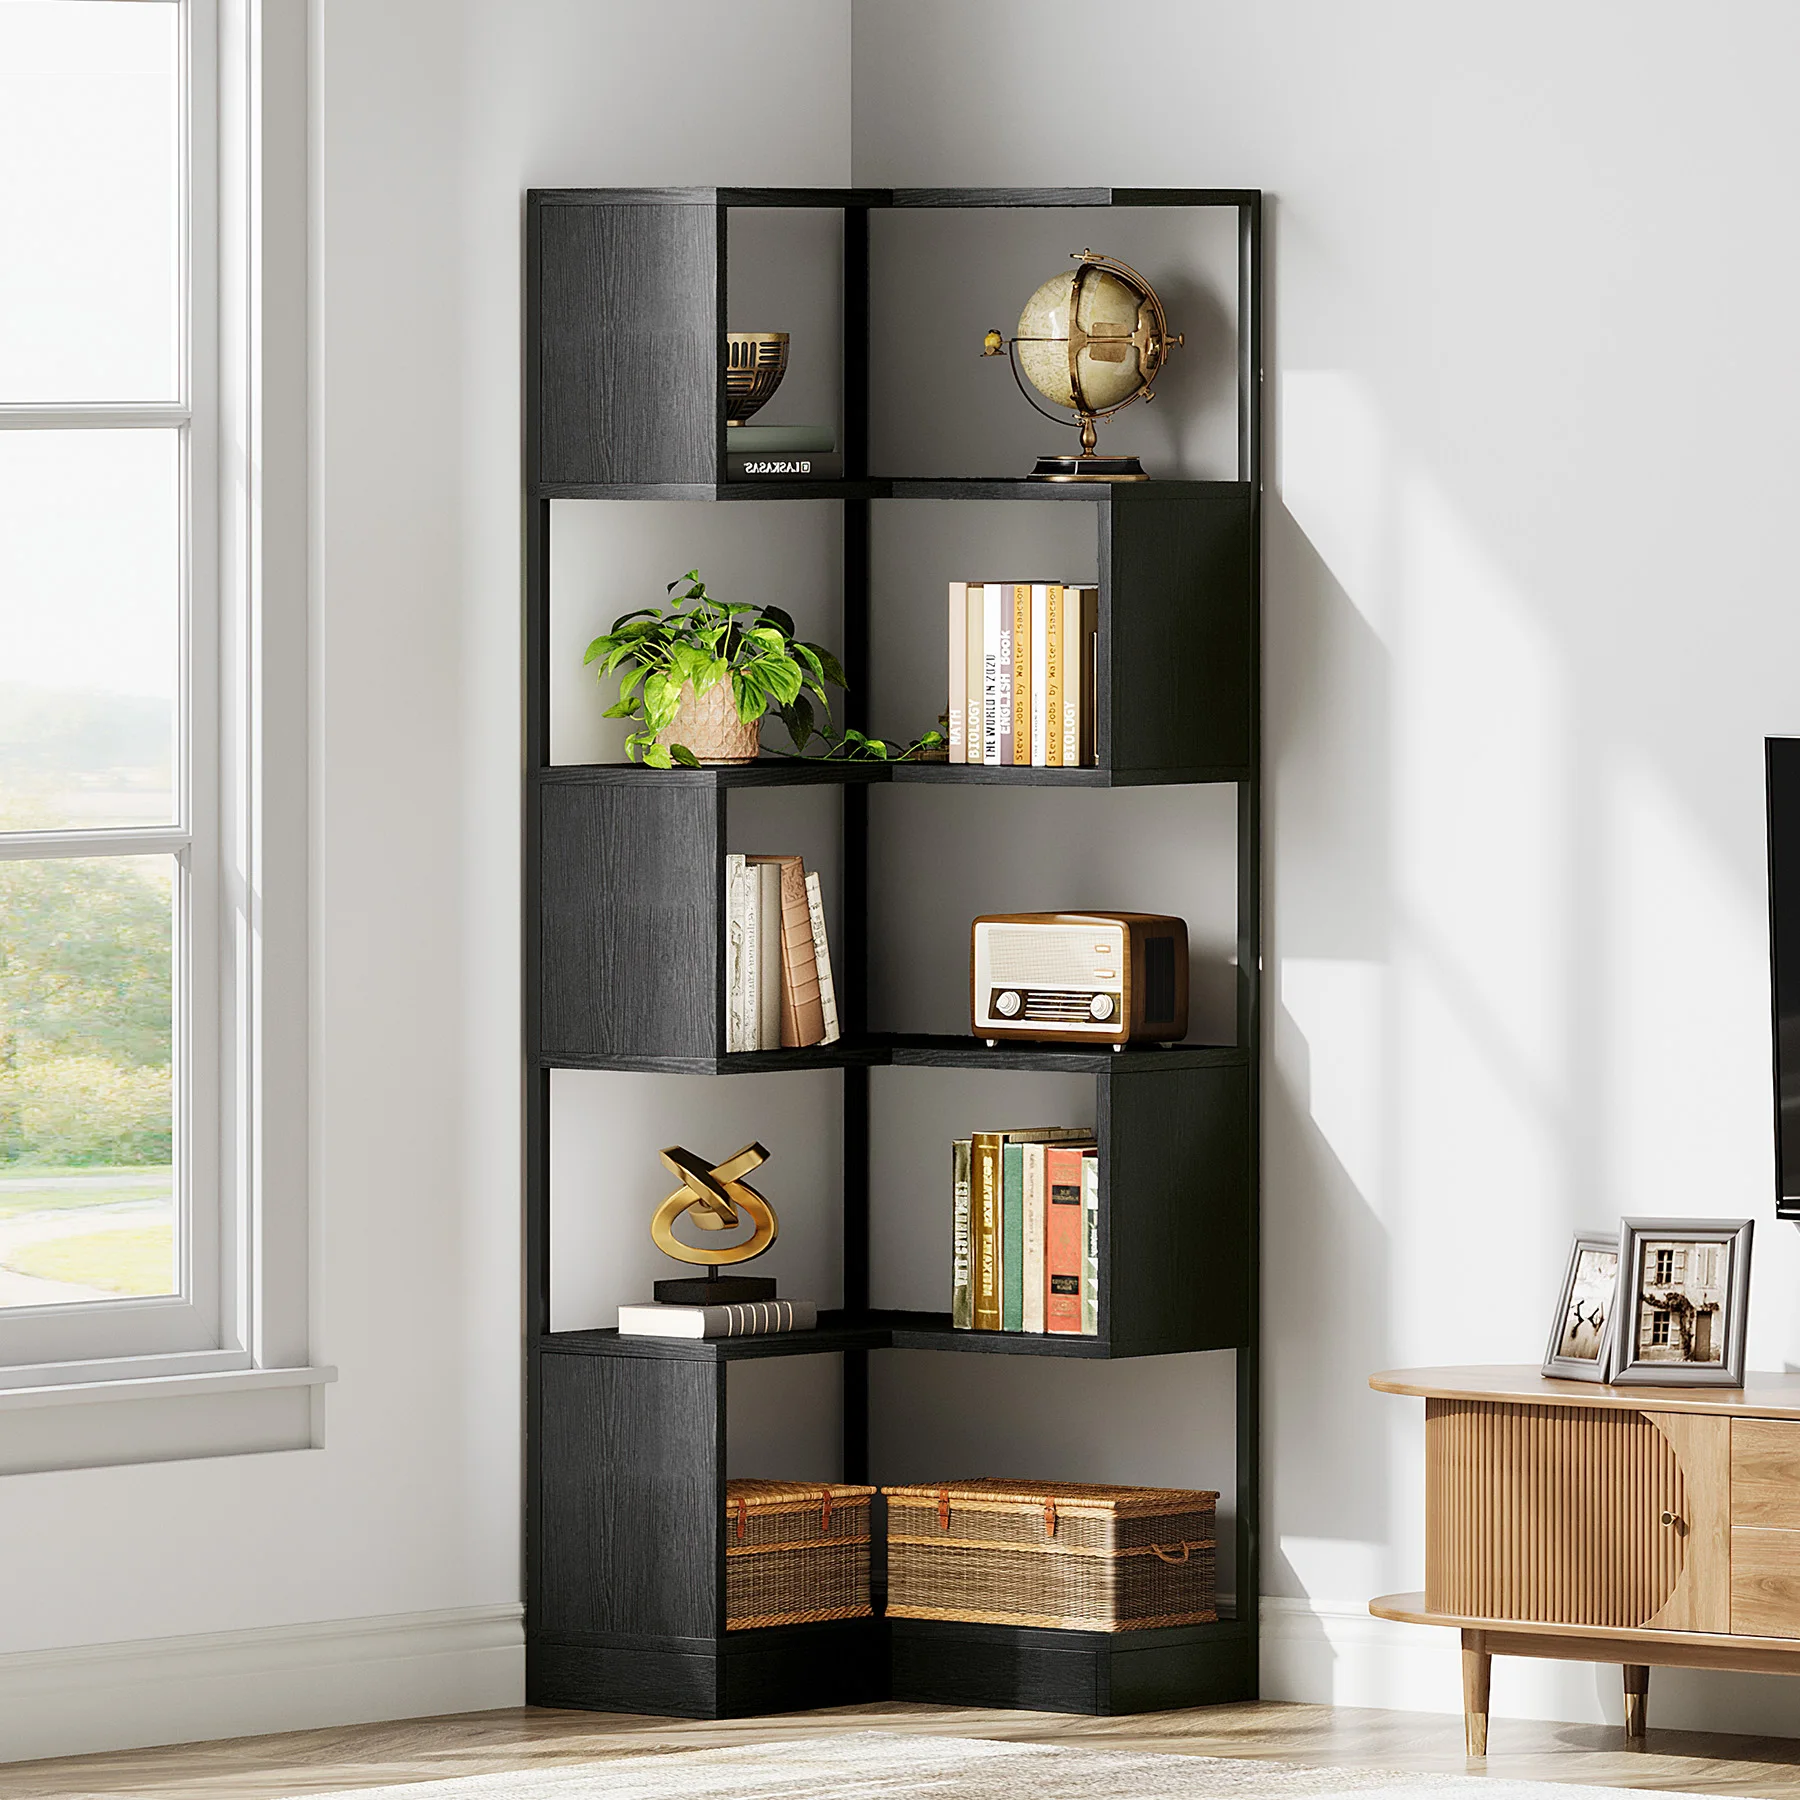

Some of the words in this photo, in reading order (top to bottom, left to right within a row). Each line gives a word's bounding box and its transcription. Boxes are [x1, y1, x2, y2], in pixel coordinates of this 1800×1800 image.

[1015, 587, 1024, 635] Isaacson
[1048, 587, 1056, 636] Isaacson
[985, 654, 996, 682] 2020
[1015, 641, 1024, 678] Walter
[1048, 642, 1056, 679] Walter
[985, 684, 996, 696] IN
[1000, 673, 1011, 735] ENGLISH
[1015, 683, 1027, 695] by
[1048, 683, 1059, 696] by
[949, 708, 962, 746] MATH
[967, 698, 981, 759] BIOLOGY
[985, 698, 996, 737] WORLD
[1015, 700, 1024, 725] Jobs
[1048, 701, 1056, 726] Jobs
[1015, 730, 1024, 761] Steve
[1048, 731, 1056, 762] Steve
[1063, 700, 1076, 761] BIOLOGY
[985, 739, 996, 759] THE
